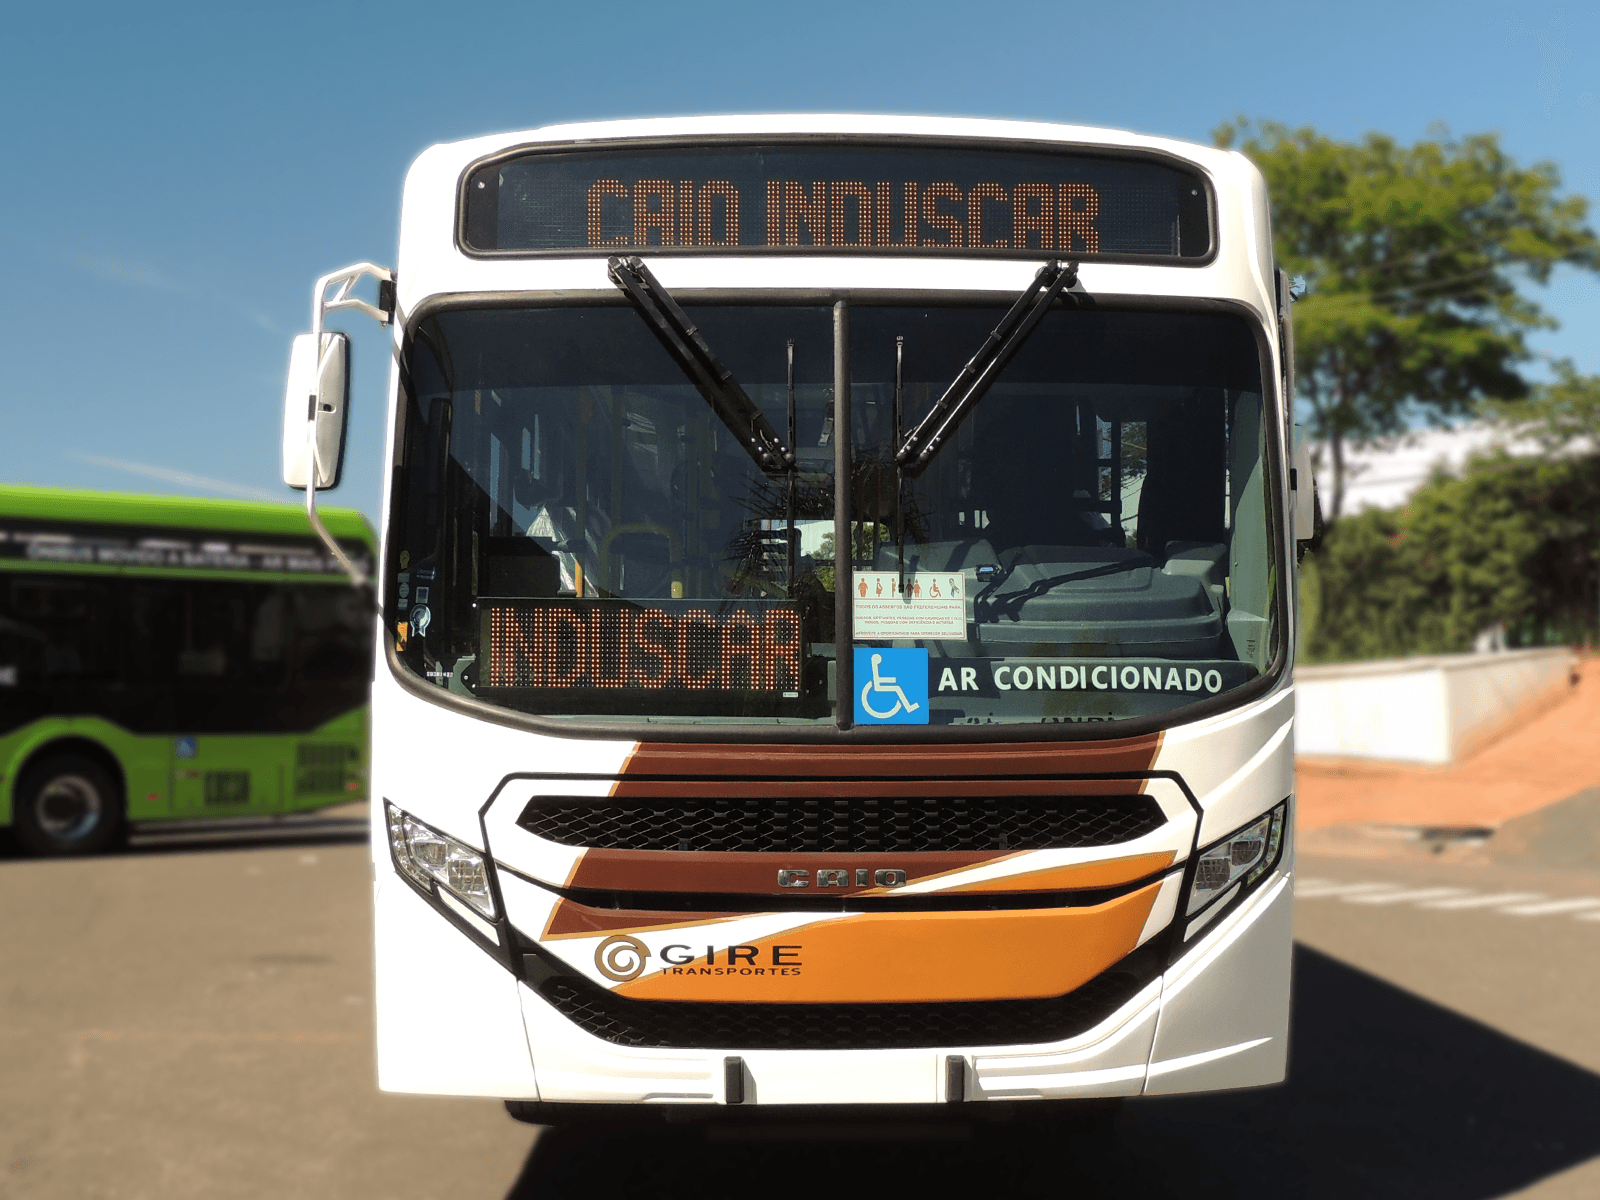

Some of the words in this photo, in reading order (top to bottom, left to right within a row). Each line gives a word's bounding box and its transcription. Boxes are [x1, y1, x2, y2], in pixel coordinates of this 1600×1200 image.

[587, 179, 740, 248] CAIO
[766, 180, 1099, 254] INDUSCAR
[491, 607, 799, 691] INDUSCAR
[938, 667, 979, 691] AR
[994, 665, 1223, 694] CONDICIONADO
[777, 869, 907, 888] CAIO
[659, 944, 803, 966] GIRE
[659, 967, 801, 976] TRANSPORTES
